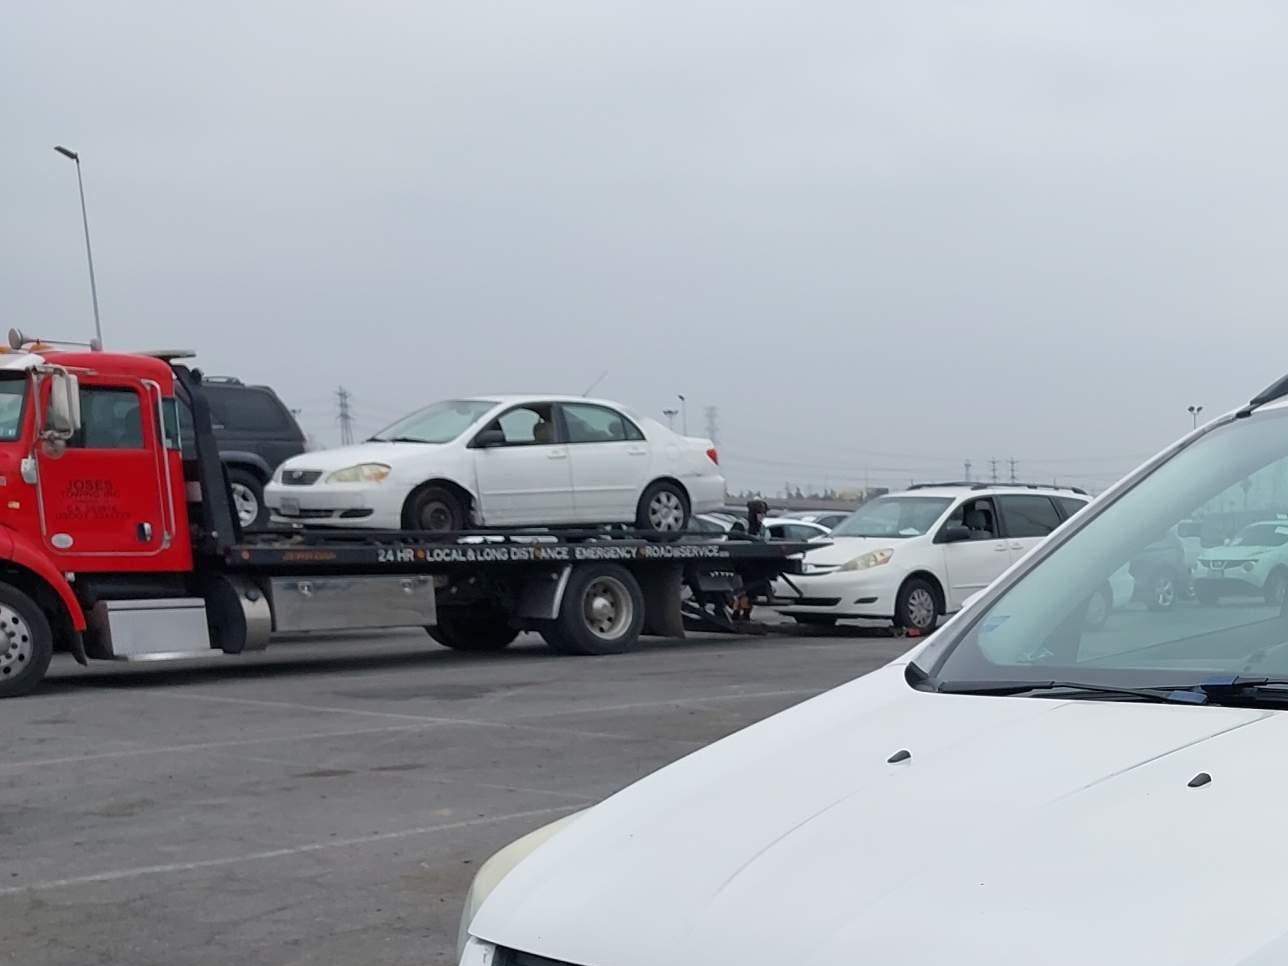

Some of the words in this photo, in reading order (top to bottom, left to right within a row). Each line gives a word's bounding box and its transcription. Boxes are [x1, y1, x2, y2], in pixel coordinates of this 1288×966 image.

[378, 551, 394, 562] 24
[397, 549, 415, 561] HR
[426, 549, 466, 561] LOCAL
[477, 549, 508, 561] LONG
[575, 547, 637, 560] EMERGENCY
[646, 546, 673, 558] ROAD
[680, 545, 719, 558] SERVICE
